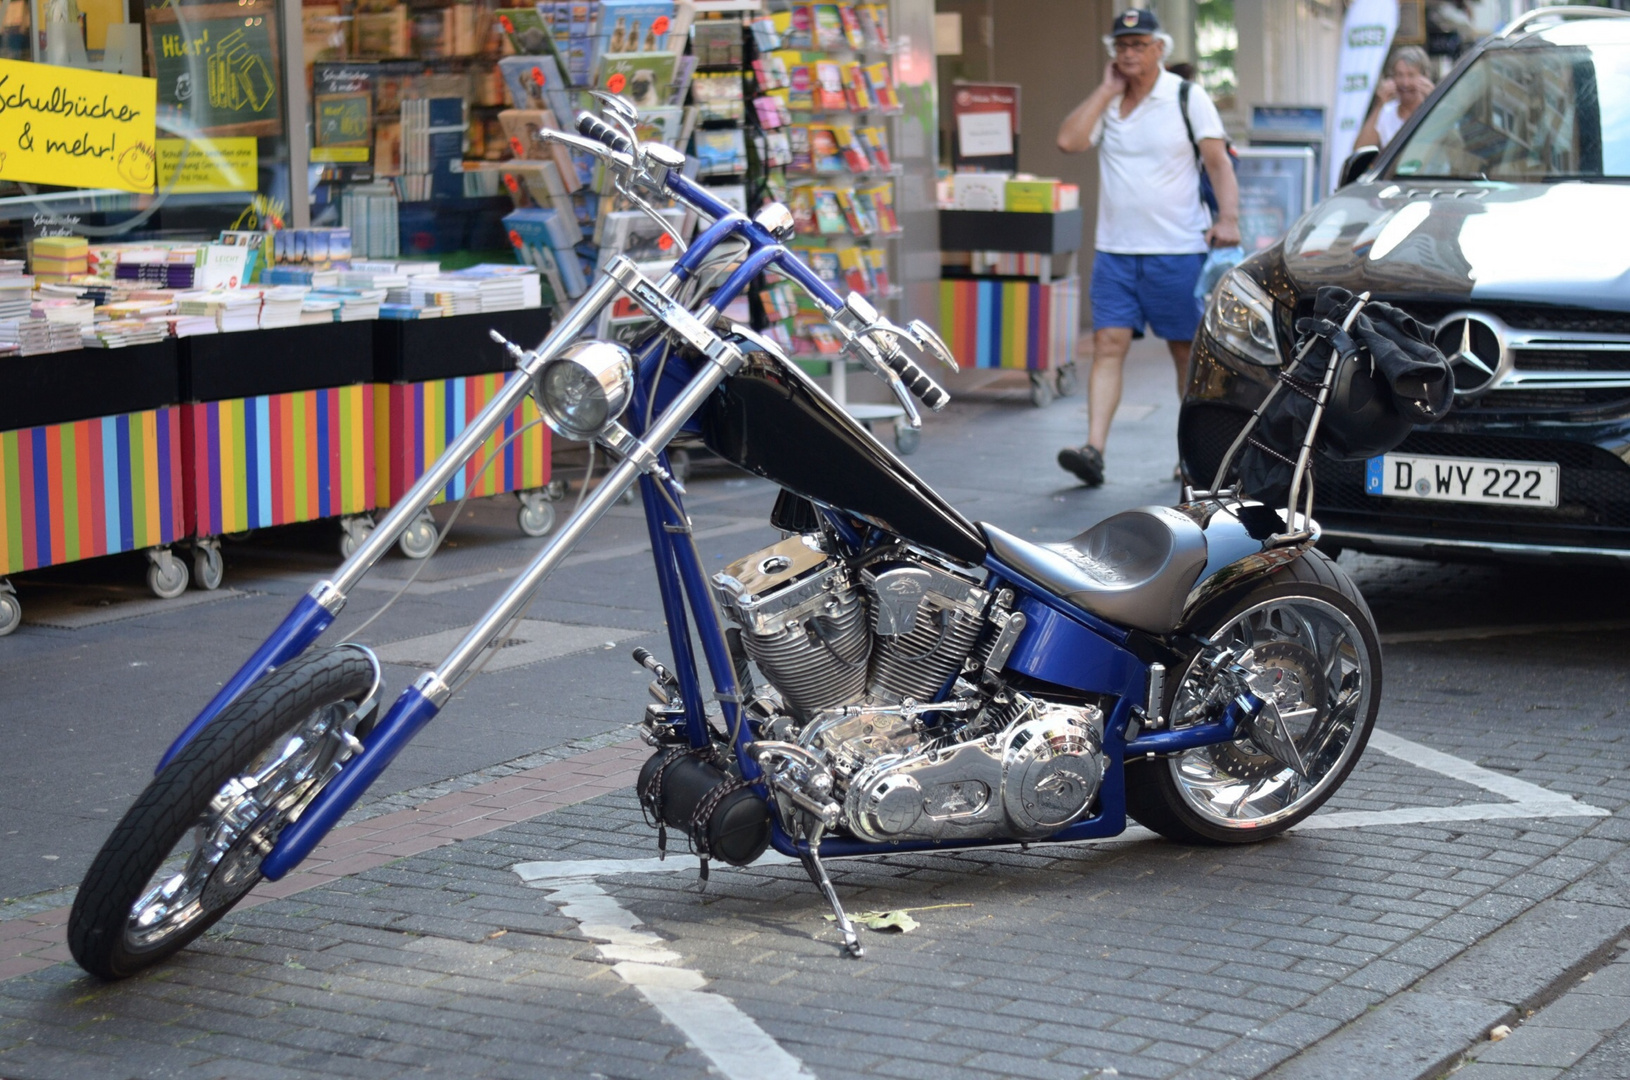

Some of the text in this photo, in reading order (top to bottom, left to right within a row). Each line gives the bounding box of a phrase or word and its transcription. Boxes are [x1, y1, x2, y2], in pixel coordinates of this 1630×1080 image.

[18, 121, 116, 161] & mehr!
[1394, 461, 1542, 500] D WY 222
